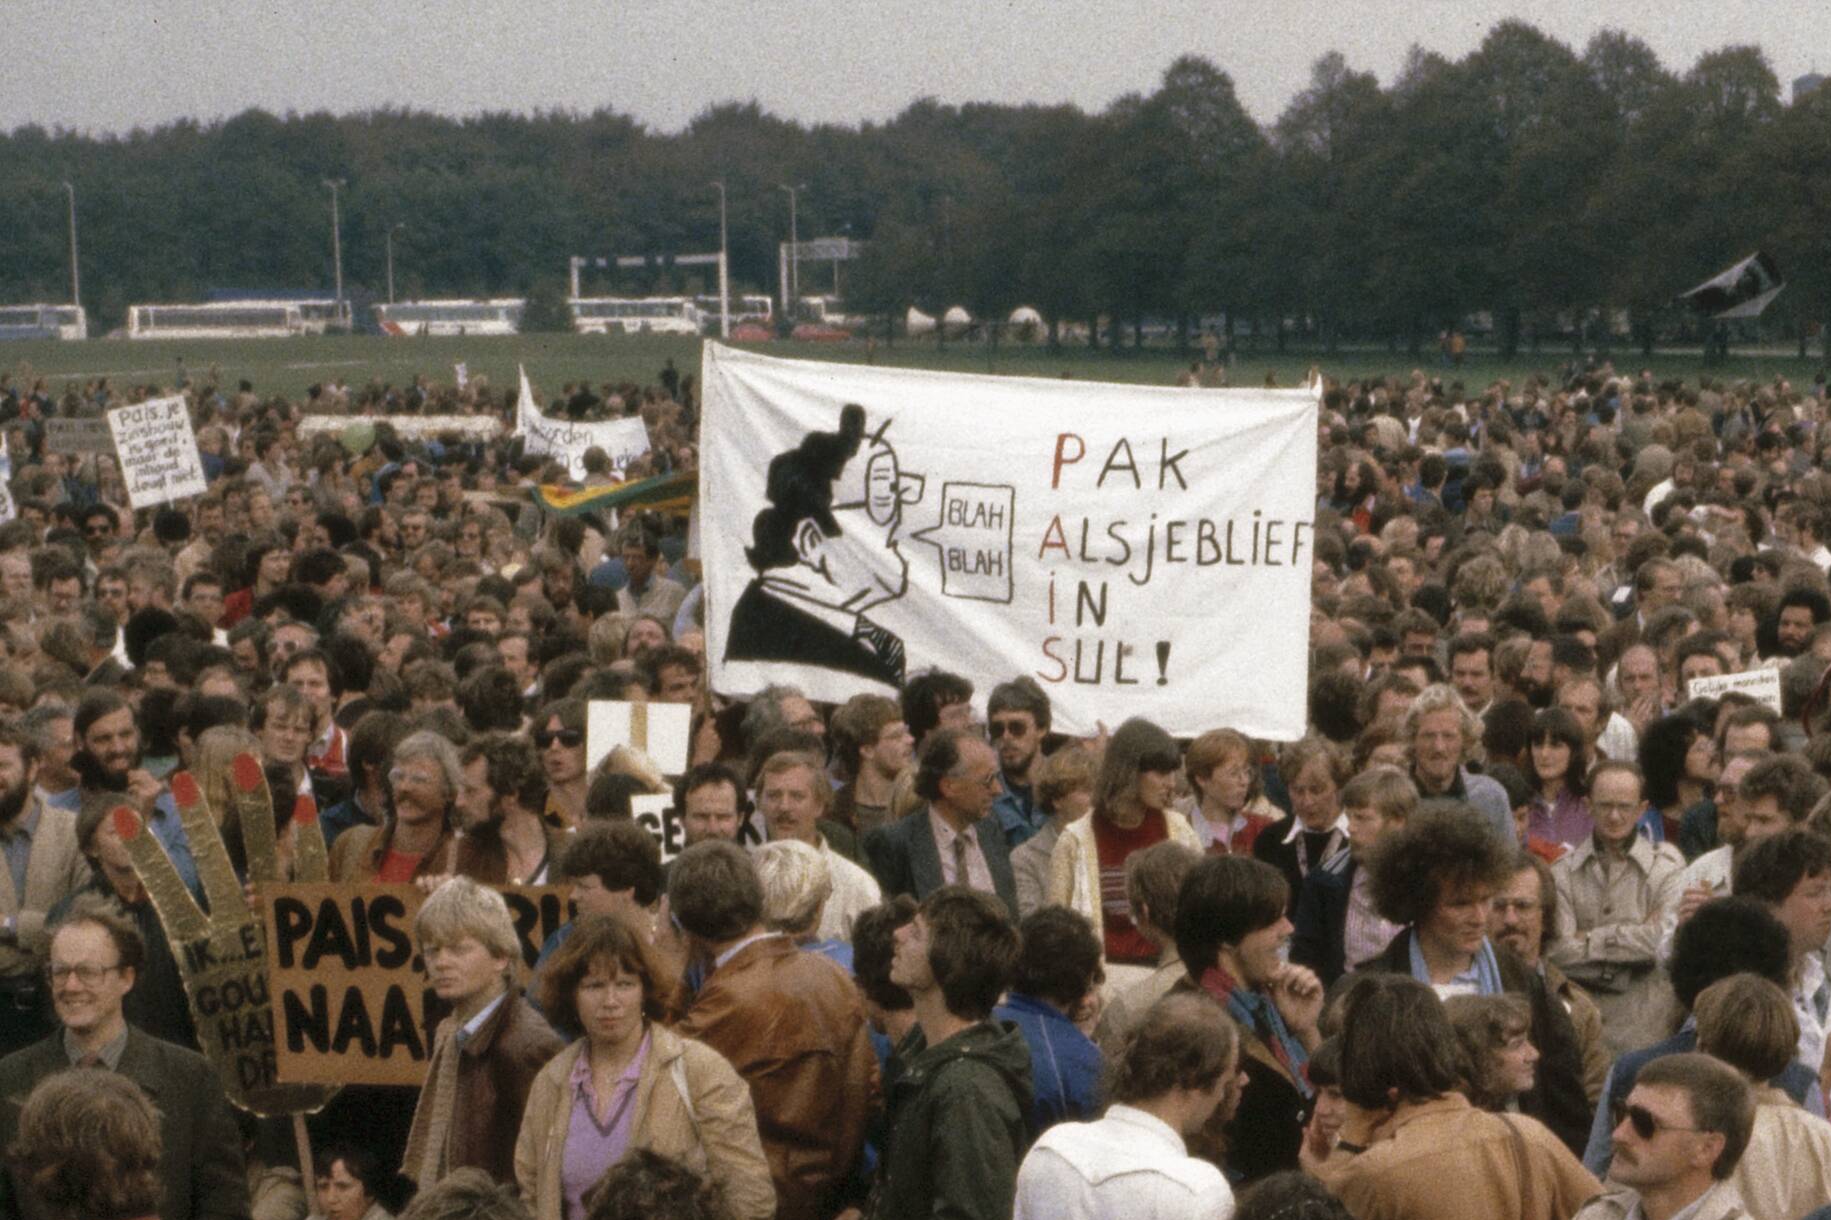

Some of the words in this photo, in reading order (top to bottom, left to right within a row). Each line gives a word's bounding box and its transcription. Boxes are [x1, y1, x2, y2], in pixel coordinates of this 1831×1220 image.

[1051, 432, 1189, 490] PAK
[949, 499, 1004, 529] BLAH
[949, 550, 1002, 577] BLAH
[1038, 509, 1314, 586] ALSJEBLIEF
[196, 972, 270, 1017] GOU
